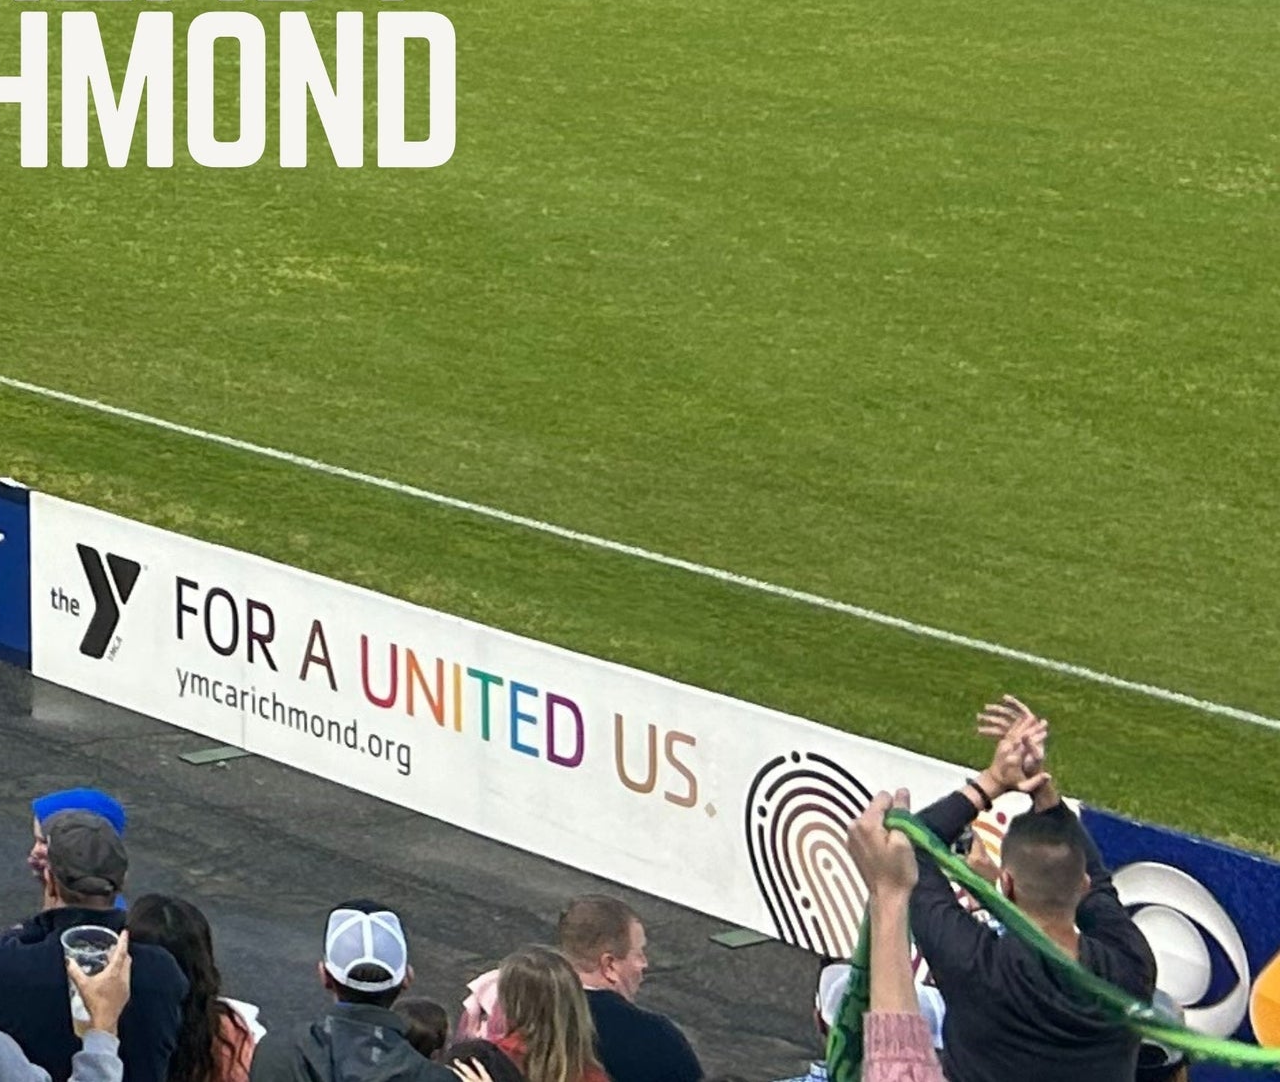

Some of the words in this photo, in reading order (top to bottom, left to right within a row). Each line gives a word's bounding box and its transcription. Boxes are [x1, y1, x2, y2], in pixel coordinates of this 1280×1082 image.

[50, 585, 81, 617] the
[75, 542, 142, 660] Y
[175, 576, 279, 673] FOR
[298, 619, 339, 692] A
[360, 633, 586, 770] UNITED
[175, 664, 413, 777] ymcarichmond.org
